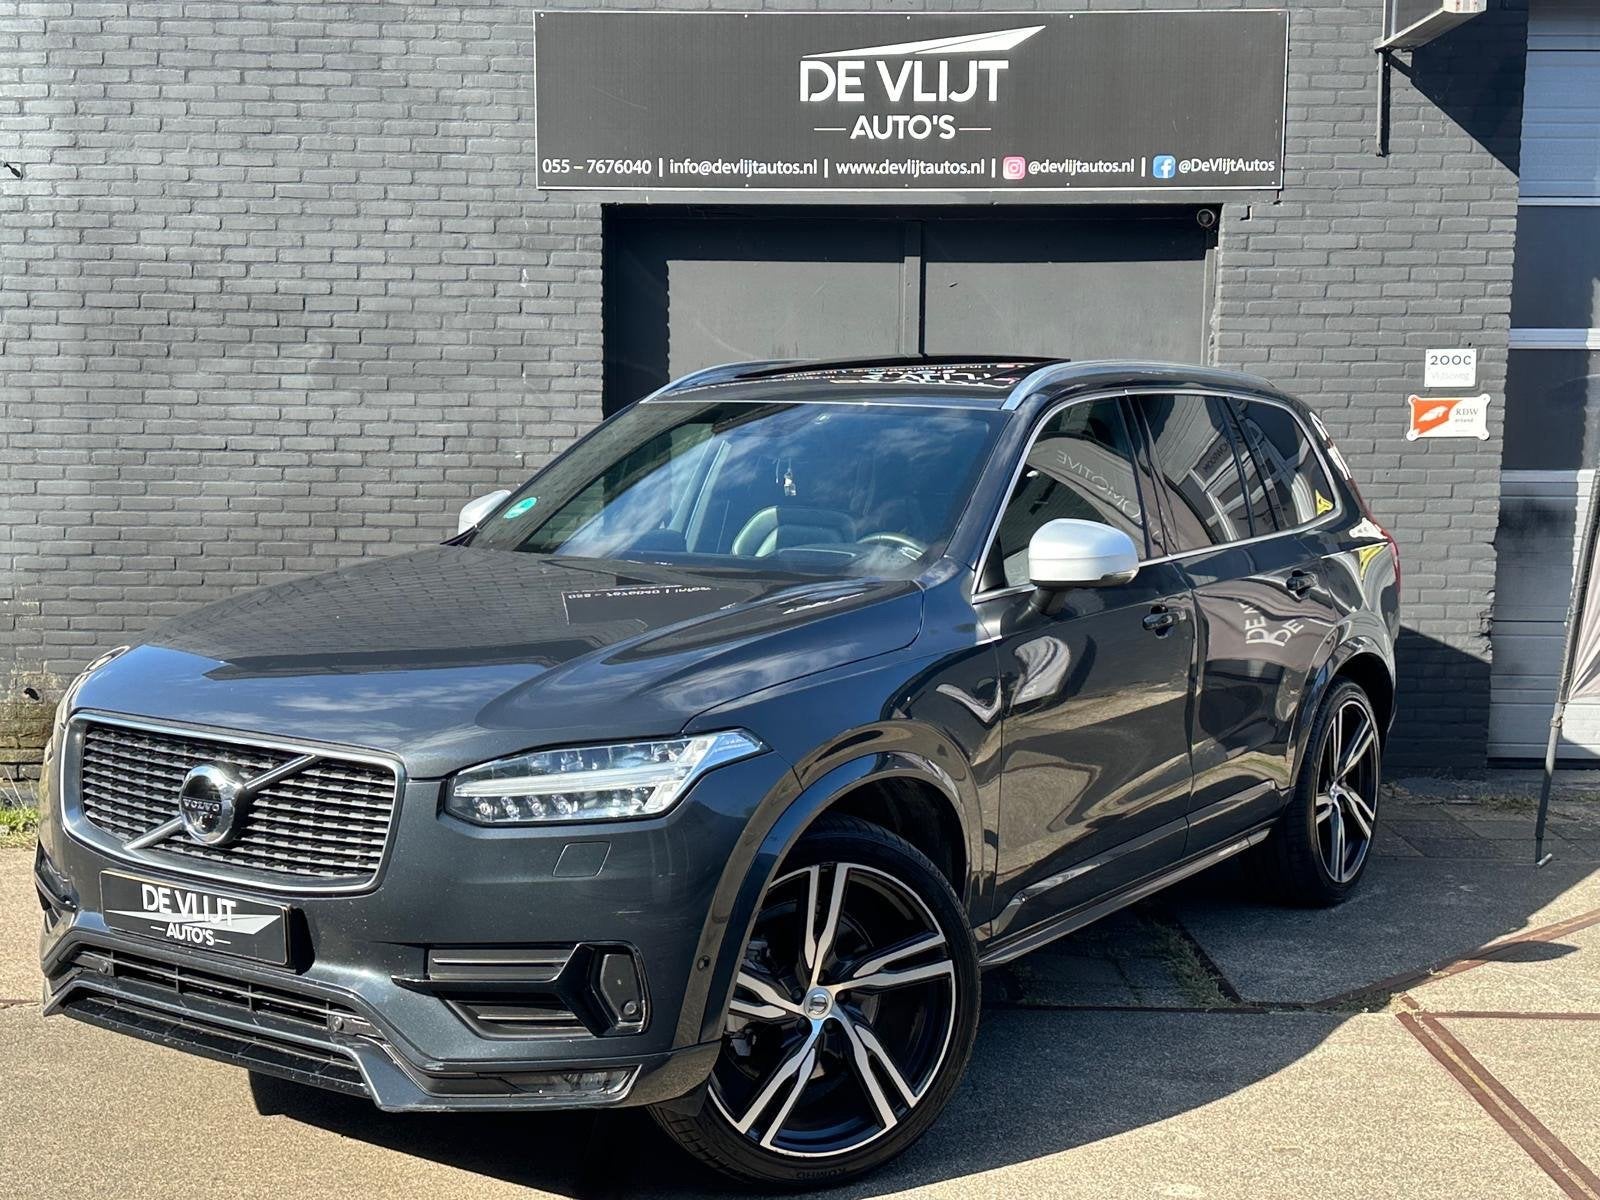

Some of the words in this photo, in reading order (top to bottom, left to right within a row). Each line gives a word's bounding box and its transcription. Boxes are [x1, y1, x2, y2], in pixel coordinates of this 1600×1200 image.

[799, 60, 865, 102] DE
[876, 60, 1009, 103] VLIJT
[850, 114, 956, 140] AUTO'S
[541, 158, 570, 174] 055
[586, 159, 652, 175] 7676040
[669, 158, 818, 178] info@devlijtautos.nl
[835, 158, 985, 178] www.devlijtautos.nl
[1028, 157, 1135, 178] @devlijtautos.nl
[1178, 157, 1276, 175] @DeVlijtAutos
[1455, 407, 1479, 416] RDW
[182, 798, 220, 812] VOLVO
[141, 884, 172, 914] DE
[174, 891, 237, 927] VLIJT
[166, 922, 216, 946] AUTO'S
